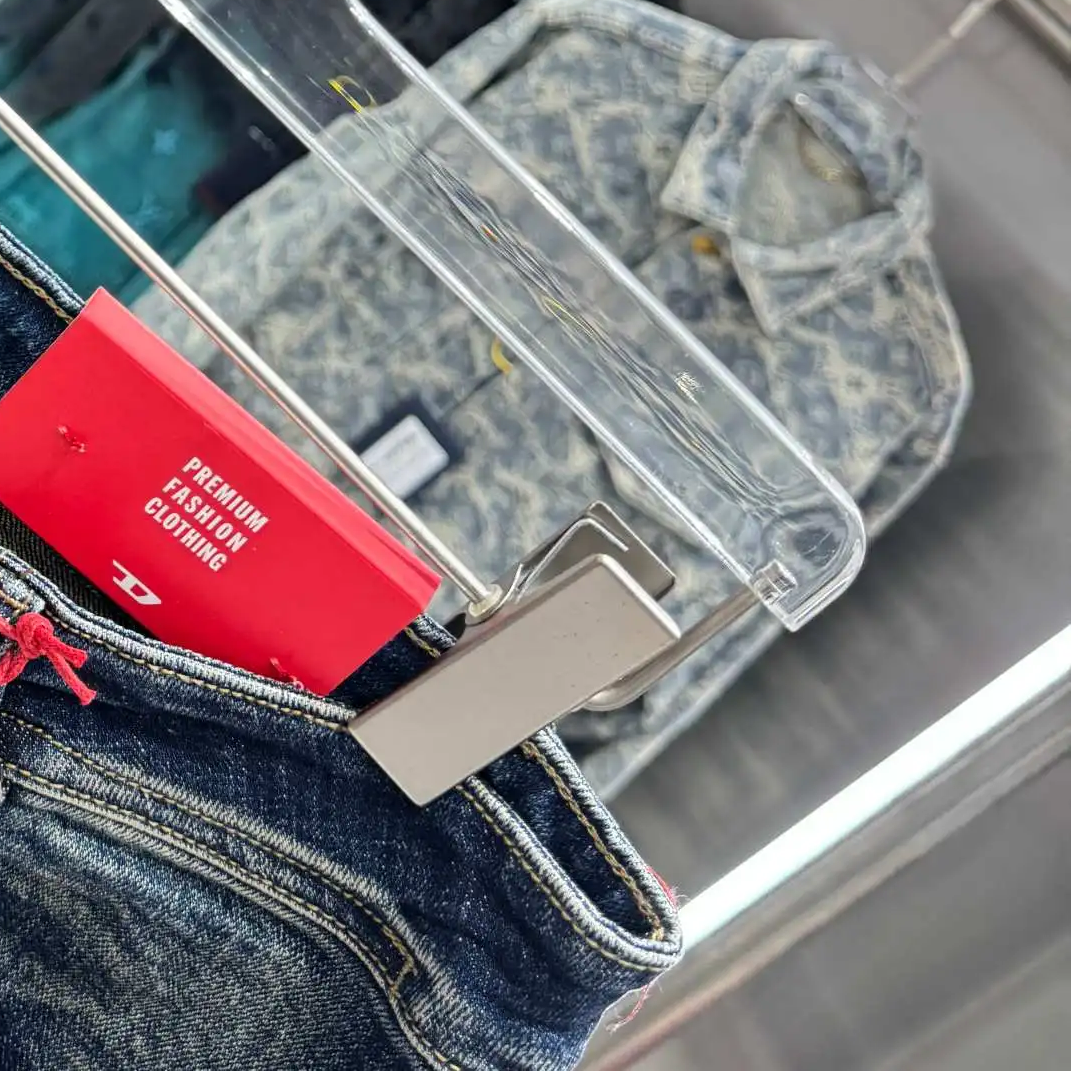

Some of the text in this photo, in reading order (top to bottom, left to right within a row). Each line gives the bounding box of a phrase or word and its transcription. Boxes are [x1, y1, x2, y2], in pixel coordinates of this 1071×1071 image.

[162, 477, 248, 553] FASHION
[182, 455, 269, 534] PREMIUM
[143, 496, 228, 572] CLOTHING
